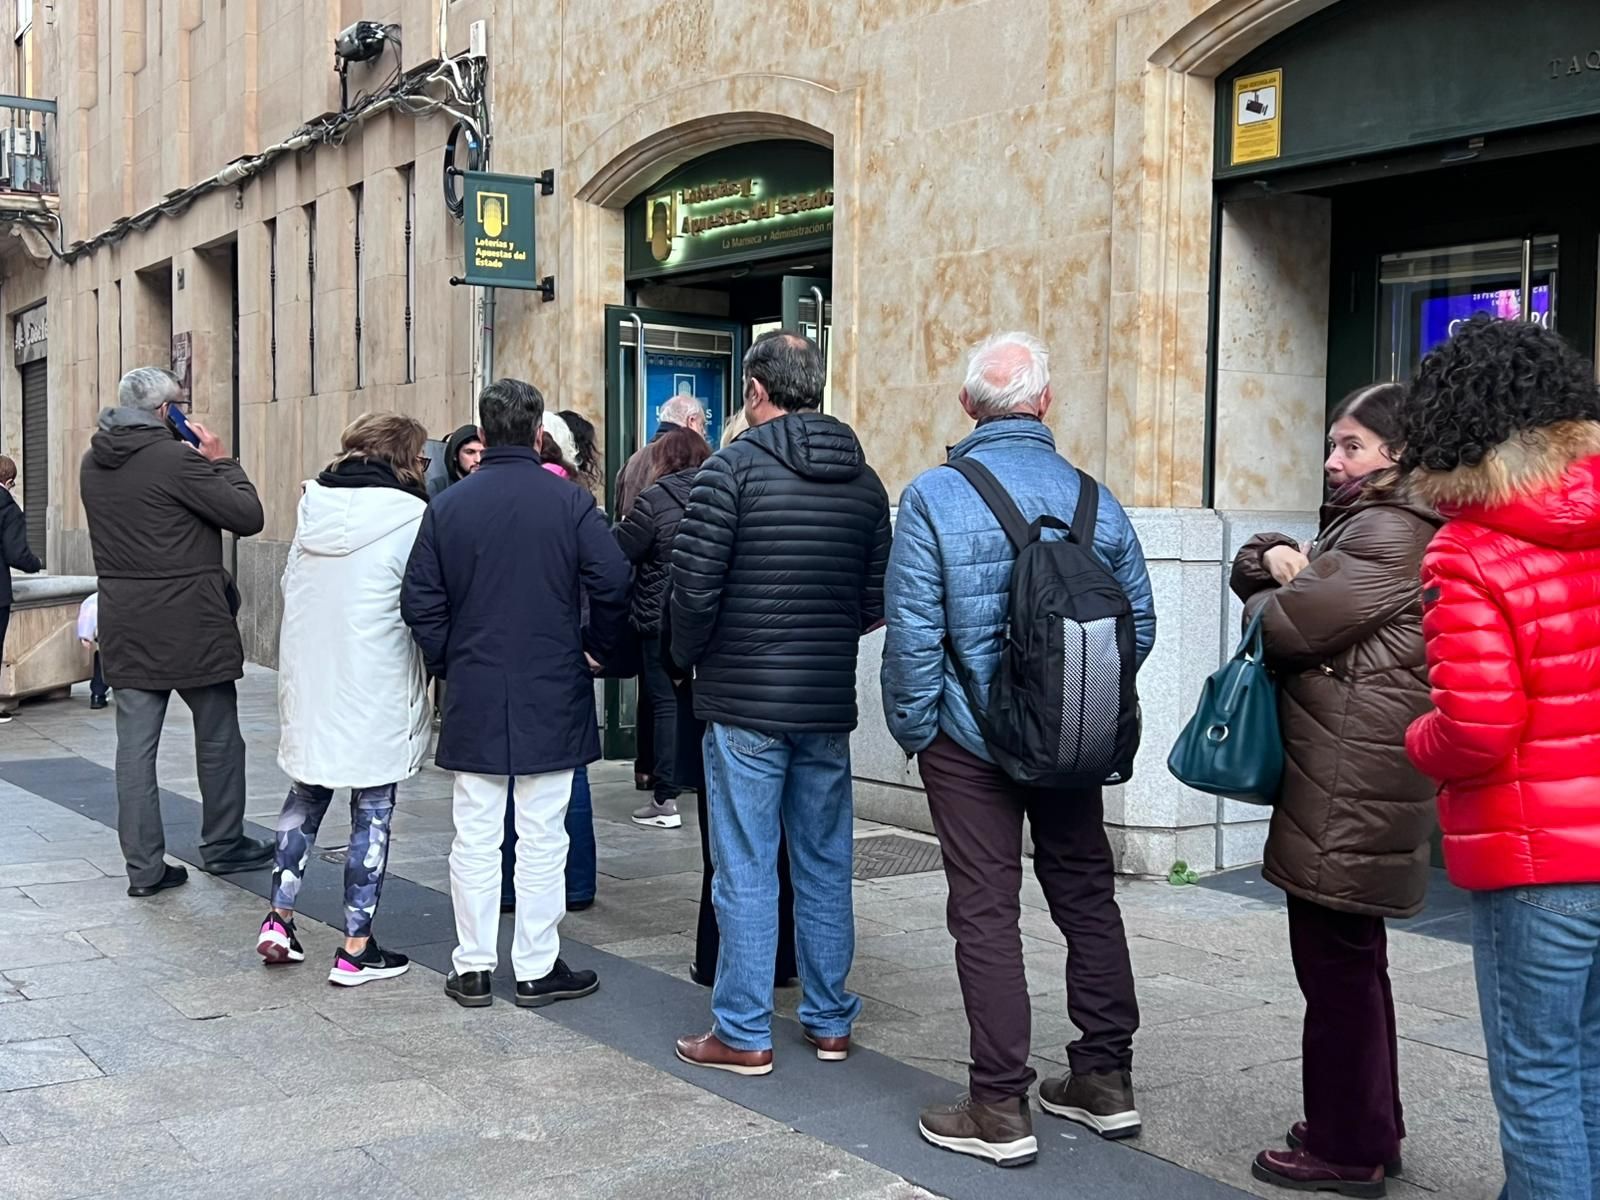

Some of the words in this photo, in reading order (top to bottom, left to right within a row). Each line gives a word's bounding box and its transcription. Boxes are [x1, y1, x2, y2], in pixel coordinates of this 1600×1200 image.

[751, 199, 776, 220] del
[777, 187, 834, 216] Estado
[475, 237, 507, 248] Loterías
[508, 242, 514, 251] y
[722, 240, 731, 250] La
[475, 247, 512, 258] Apuestas
[513, 250, 526, 260] del
[475, 257, 503, 268] Estado
